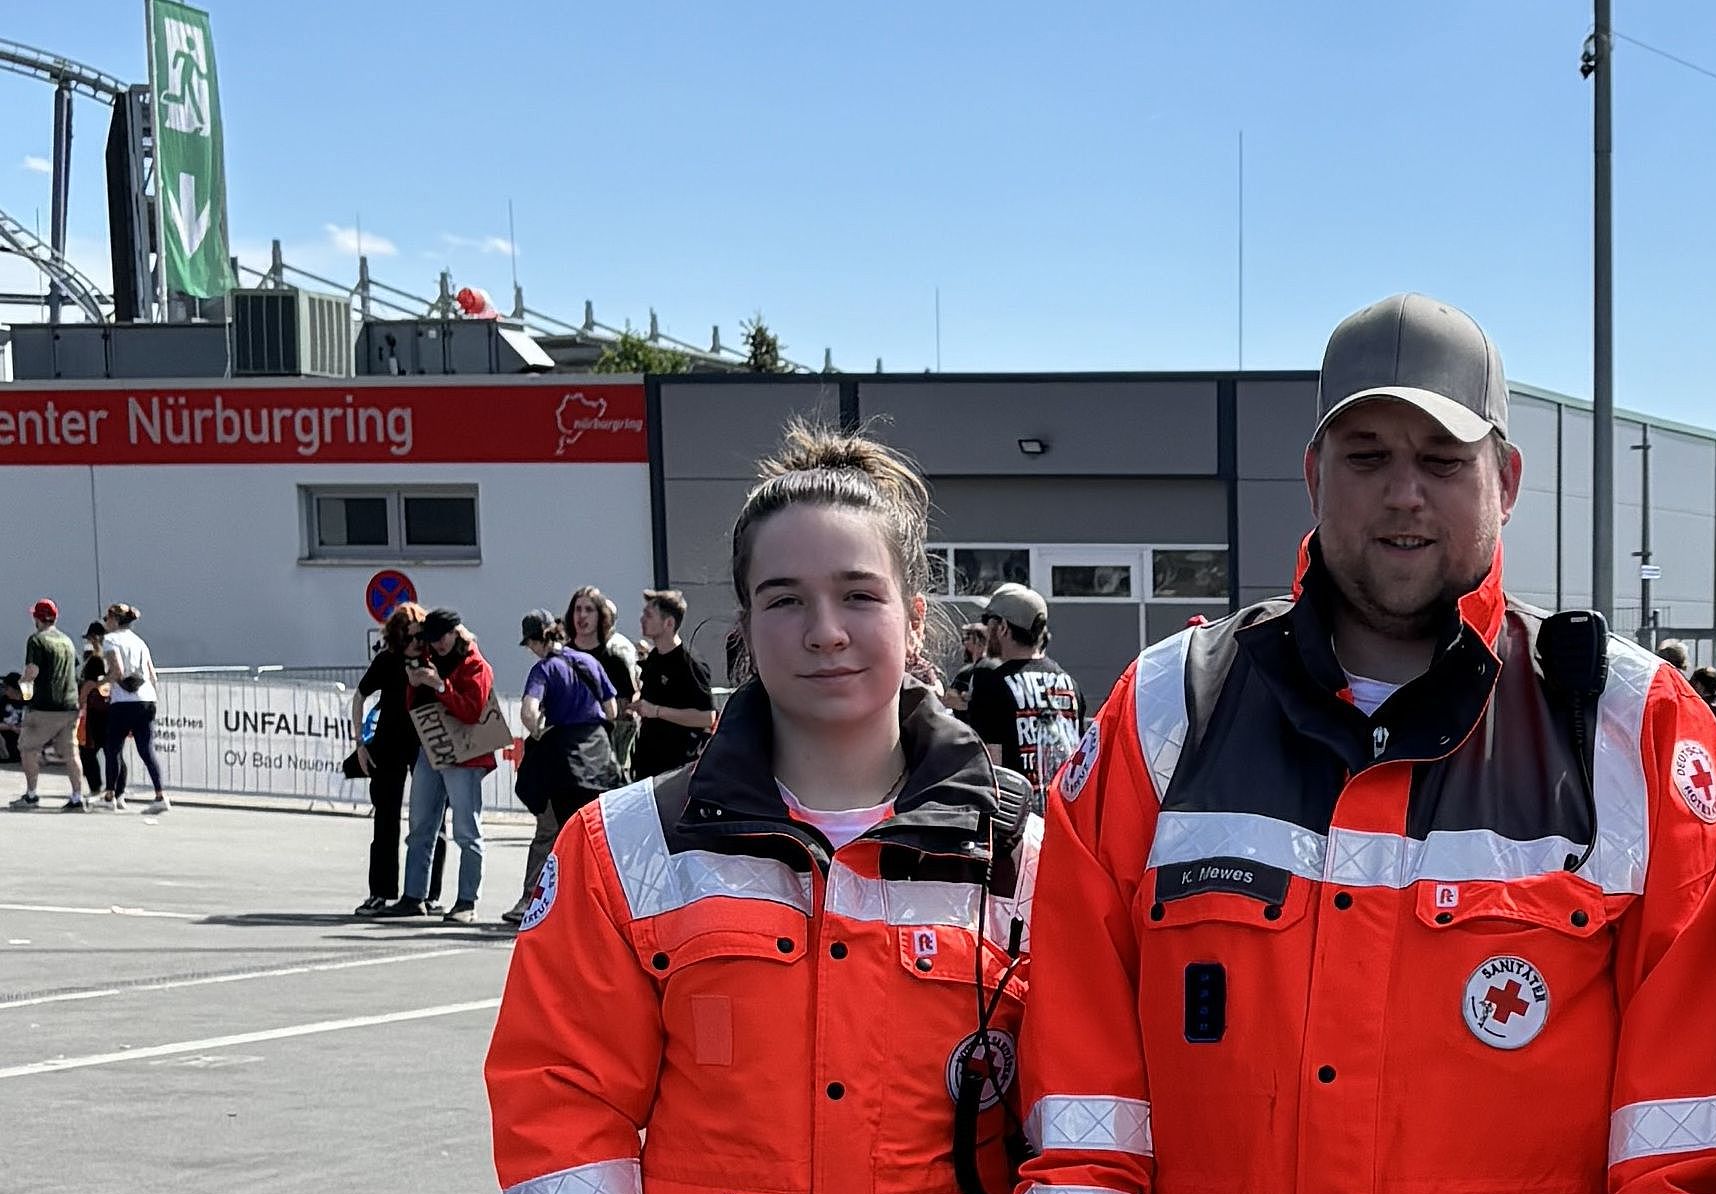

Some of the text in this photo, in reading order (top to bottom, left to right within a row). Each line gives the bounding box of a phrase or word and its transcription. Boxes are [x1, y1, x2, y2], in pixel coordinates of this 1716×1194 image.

[127, 395, 413, 456] Nürburgring
[224, 750, 246, 766] OV
[253, 753, 282, 769] Bad
